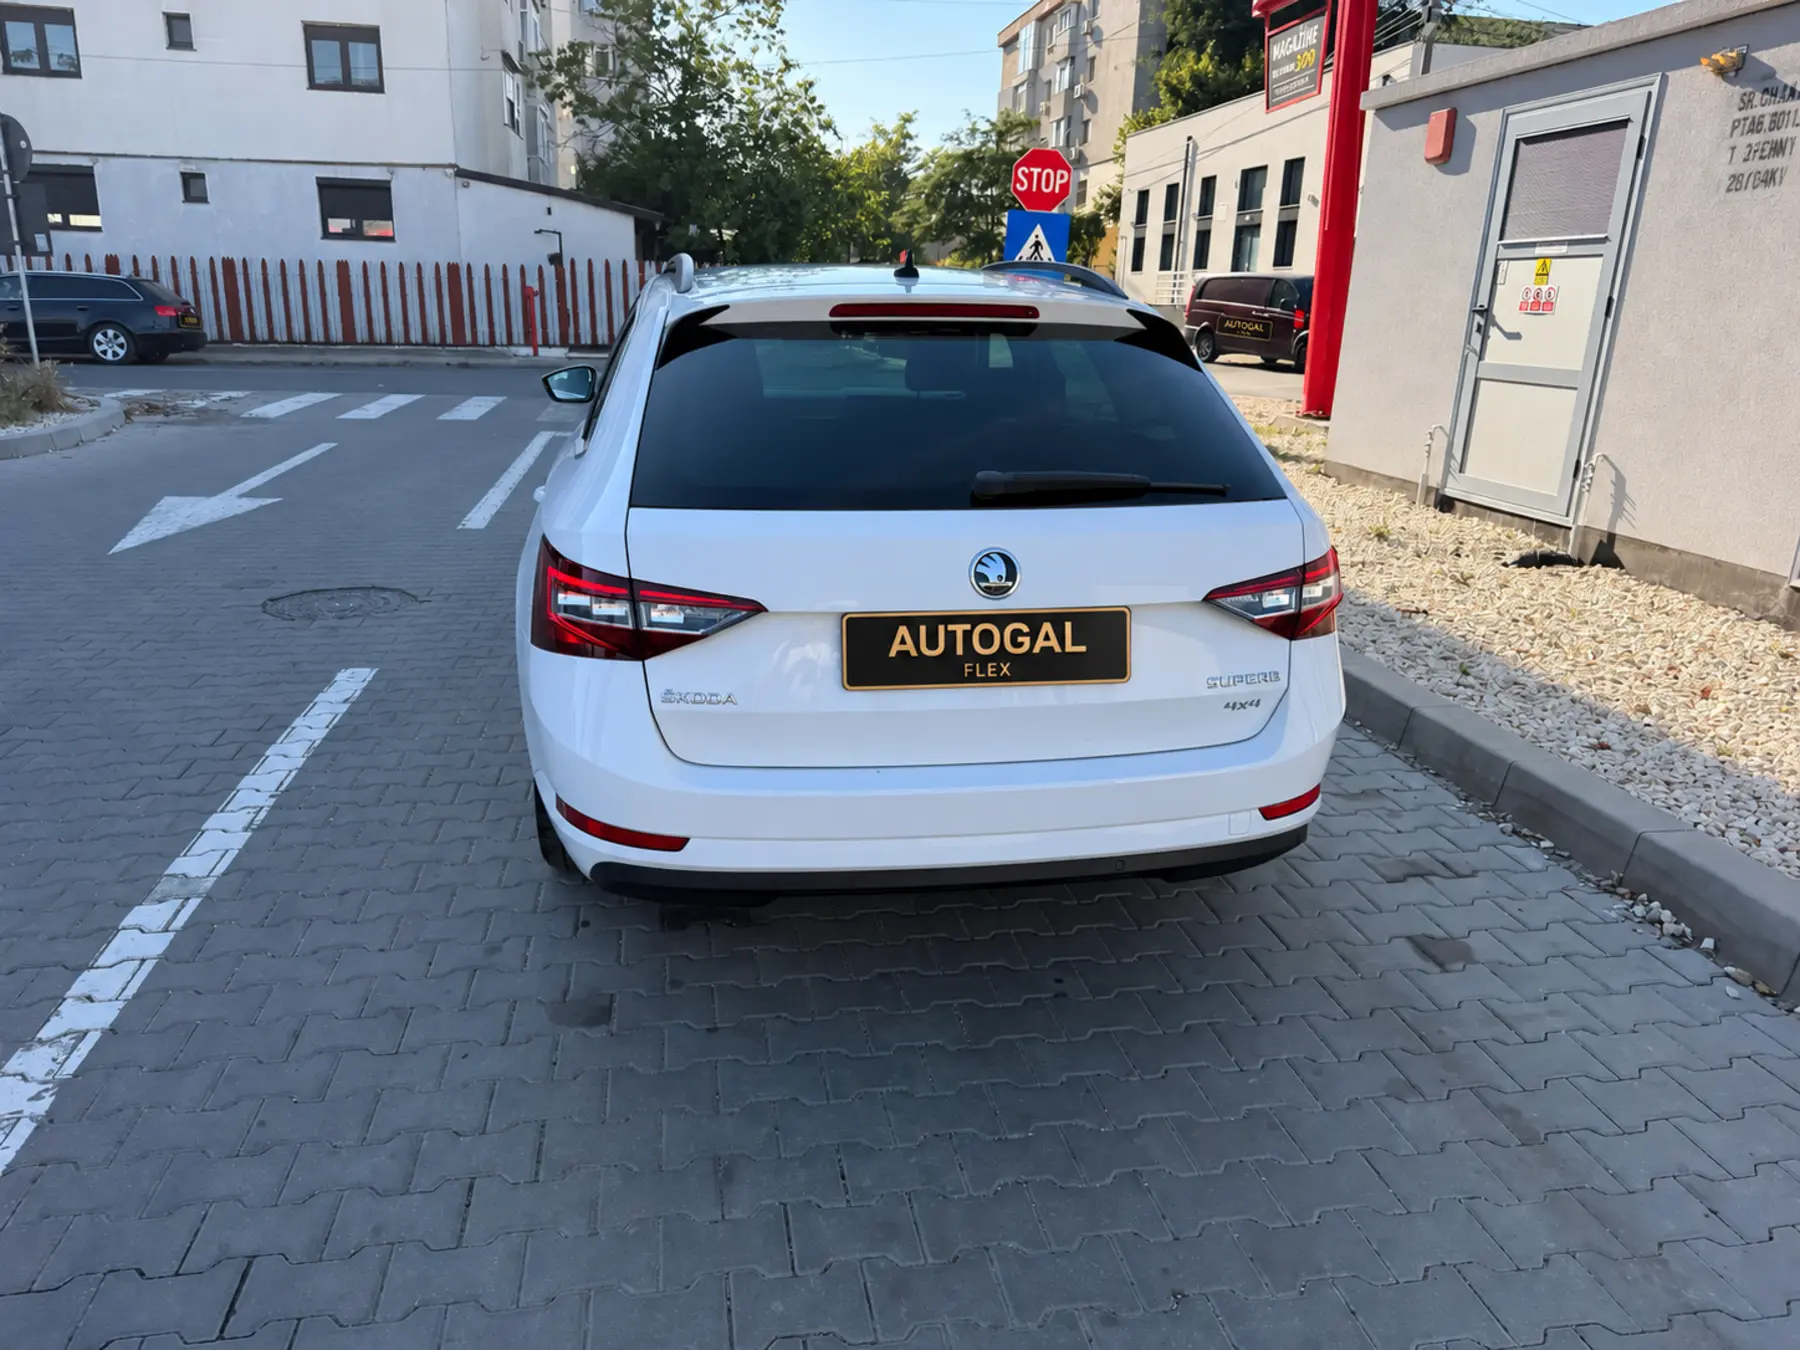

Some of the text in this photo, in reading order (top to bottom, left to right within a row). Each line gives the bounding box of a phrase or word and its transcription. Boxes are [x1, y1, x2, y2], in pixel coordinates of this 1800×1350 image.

[1016, 166, 1069, 194] STOP
[888, 621, 1087, 657] AUTOGAL
[964, 662, 1012, 678] FLEX
